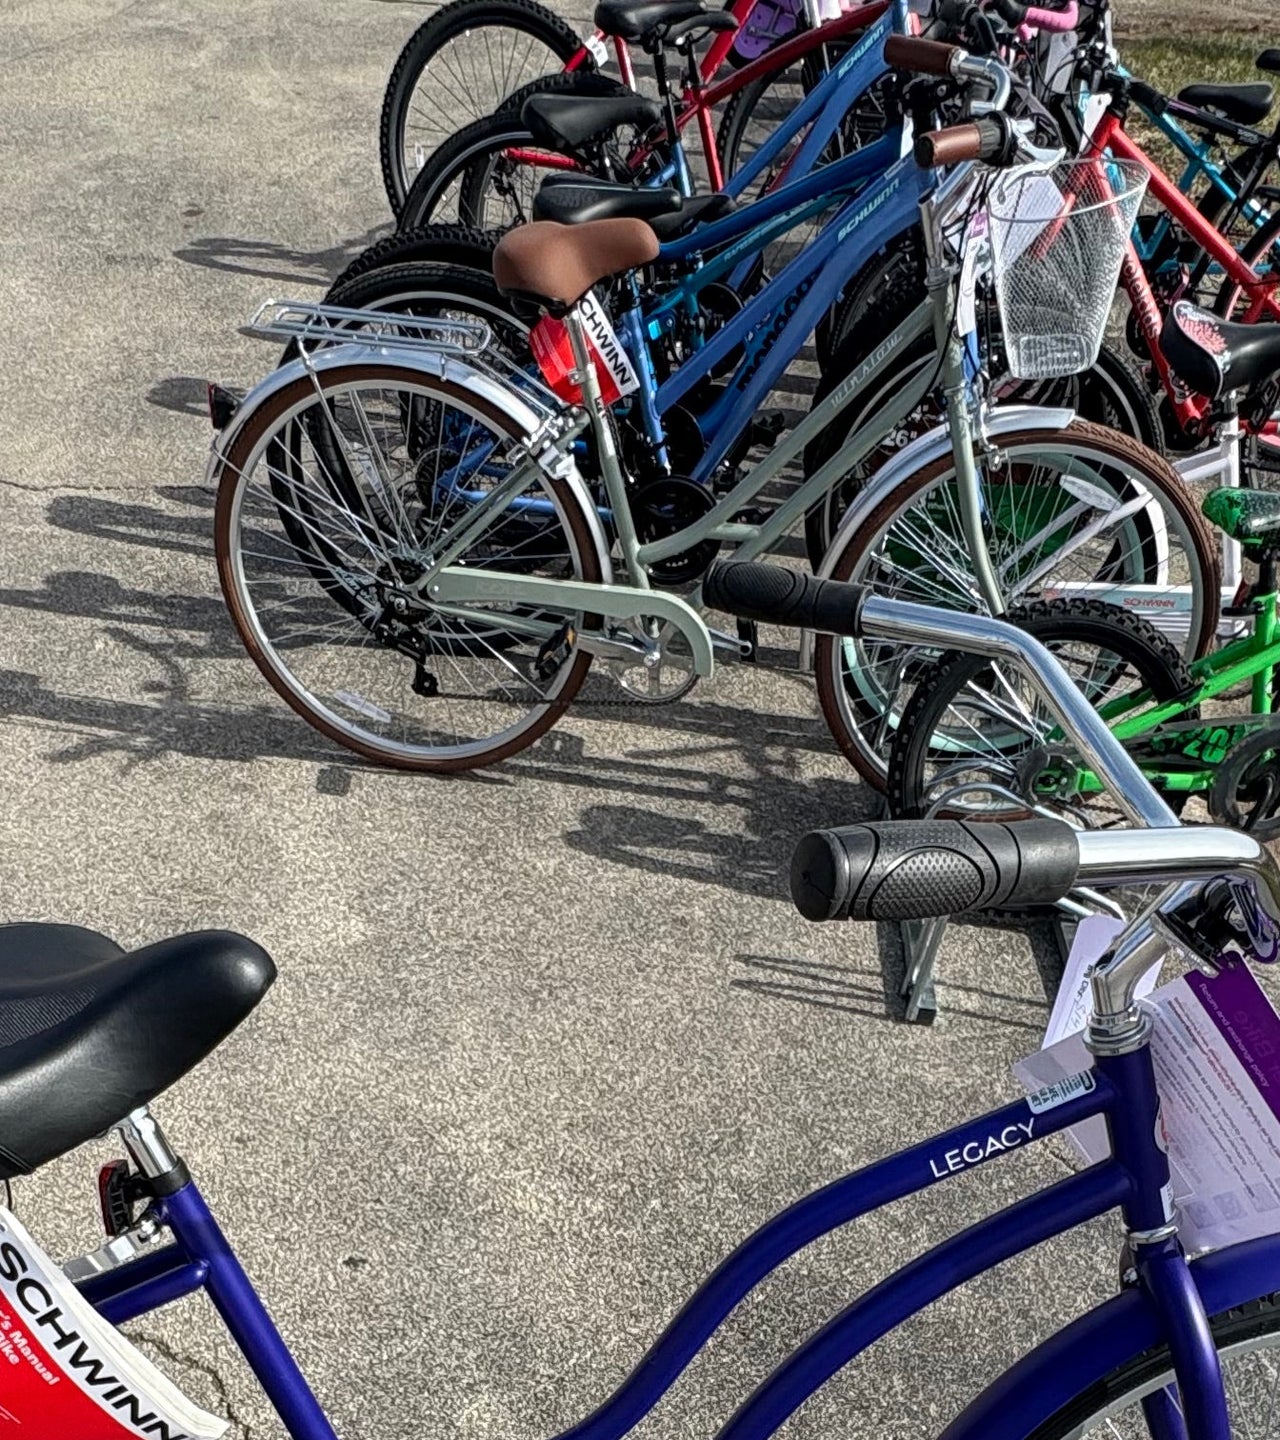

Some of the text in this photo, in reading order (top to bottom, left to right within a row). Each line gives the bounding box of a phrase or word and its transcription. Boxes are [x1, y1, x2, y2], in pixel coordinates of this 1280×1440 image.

[579, 298, 632, 387] CHWINN
[929, 1117, 1035, 1178] LEGACY
[9, 1330, 61, 1386] Manual
